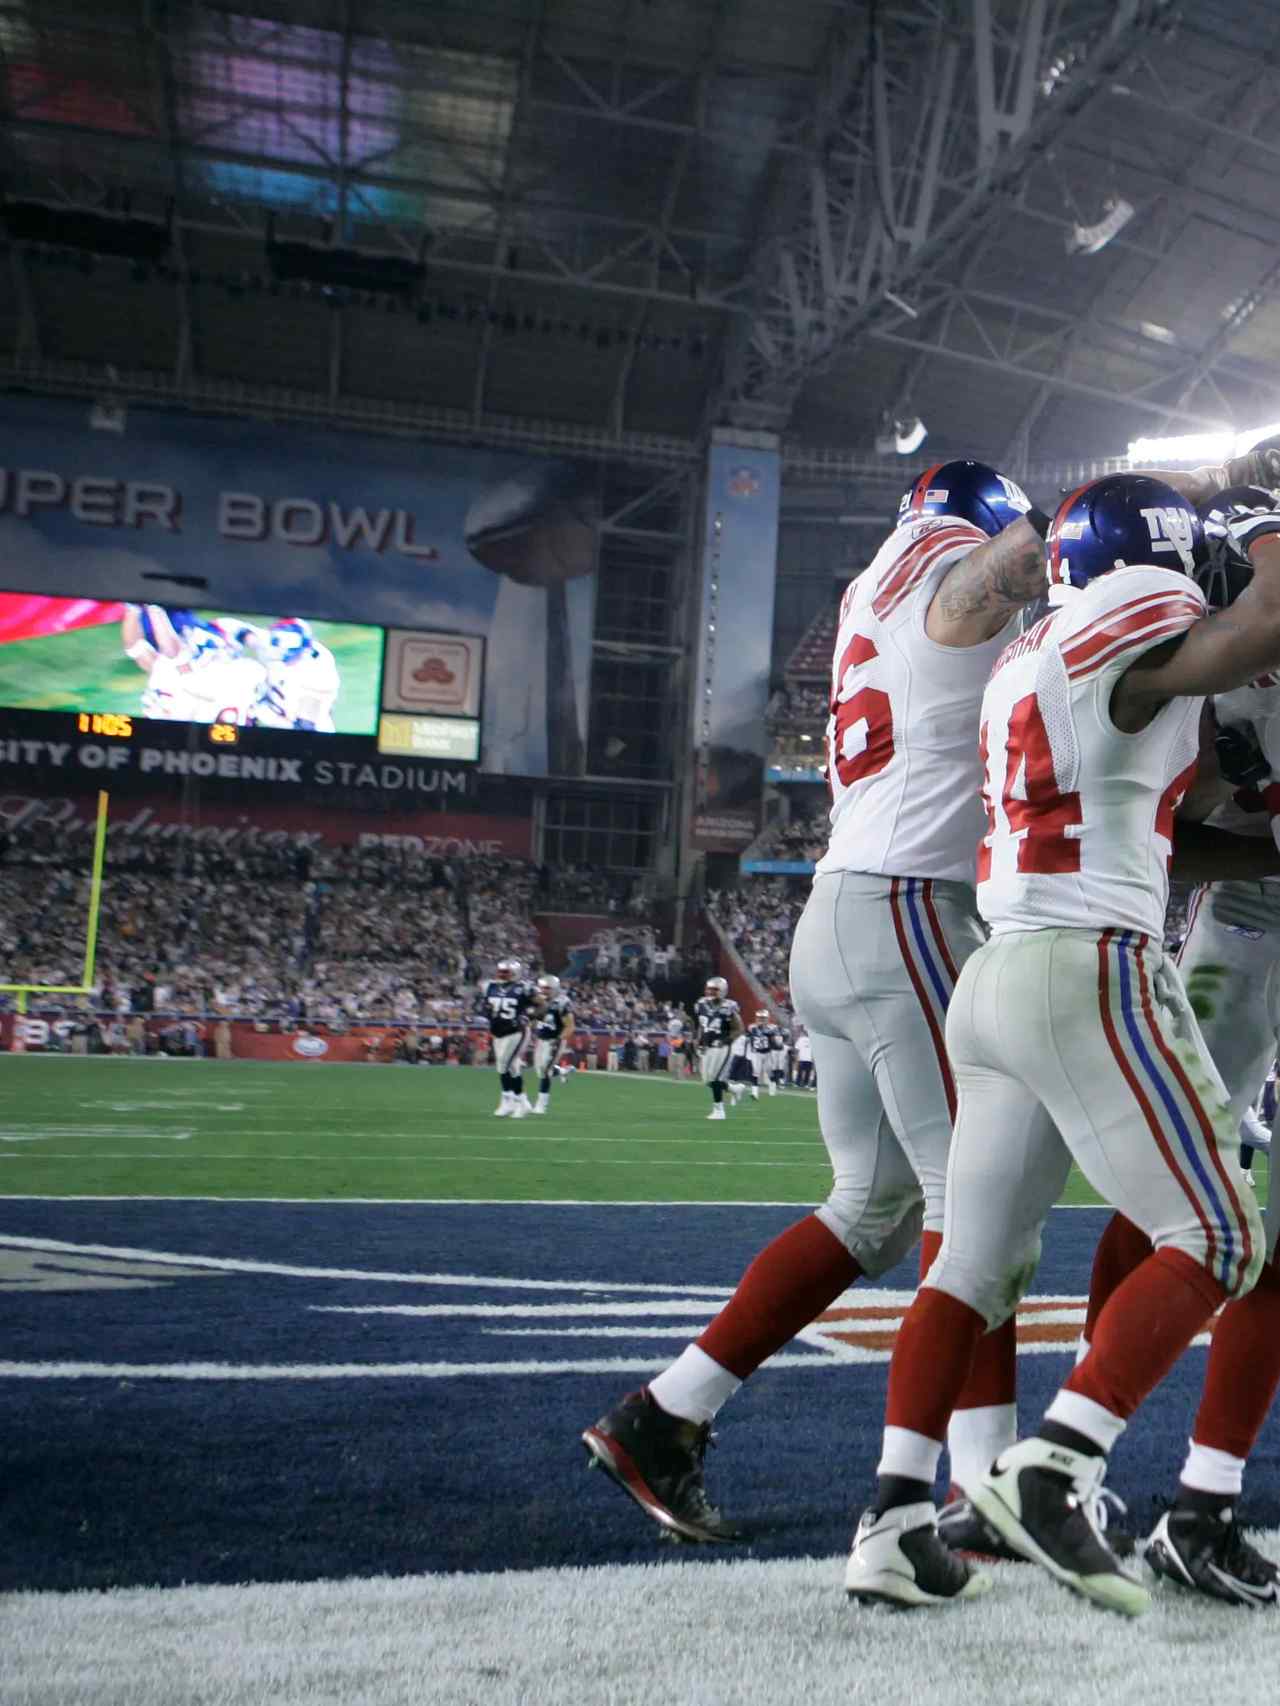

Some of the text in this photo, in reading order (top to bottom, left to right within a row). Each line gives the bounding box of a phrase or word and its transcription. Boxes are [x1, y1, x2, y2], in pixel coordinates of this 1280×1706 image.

[0, 467, 438, 560] PER BOWL
[826, 632, 896, 788] 6
[79, 743, 131, 771] OF
[140, 748, 304, 783] PHOENIX
[314, 759, 468, 794] STADIUM
[976, 691, 1084, 886] 4
[487, 996, 518, 1020] 75
